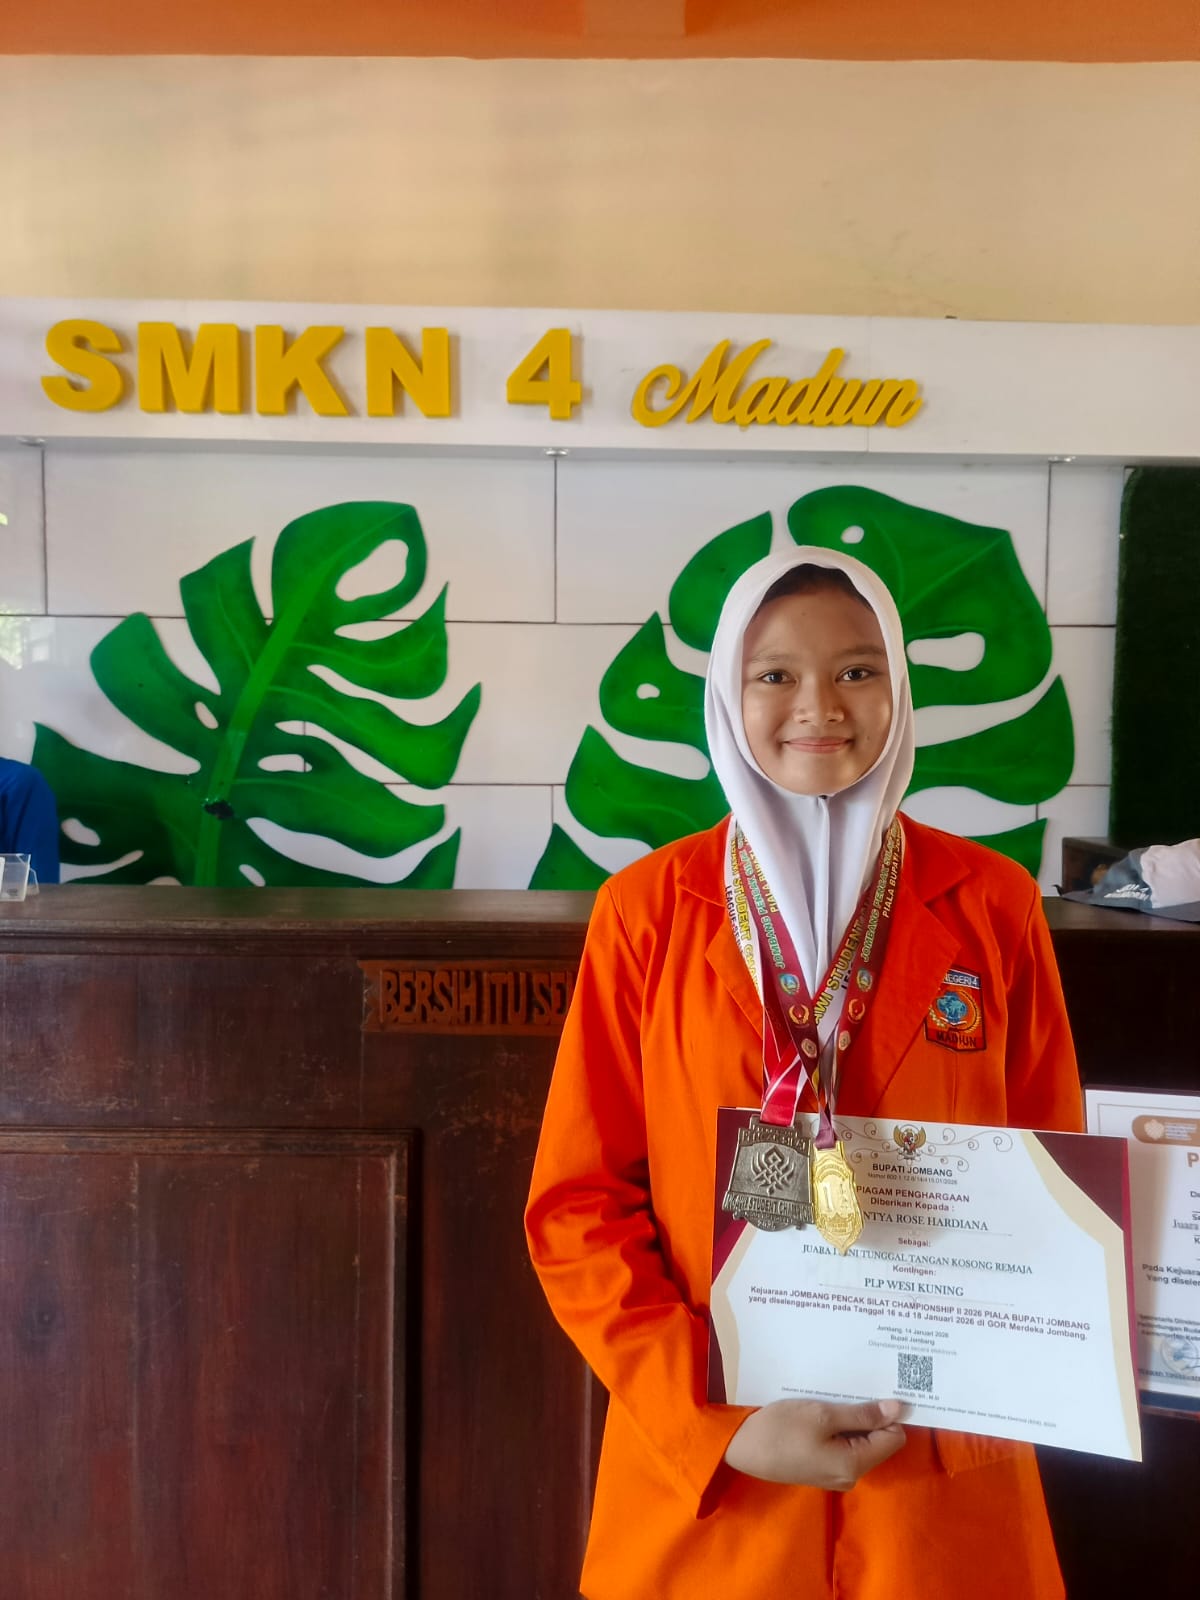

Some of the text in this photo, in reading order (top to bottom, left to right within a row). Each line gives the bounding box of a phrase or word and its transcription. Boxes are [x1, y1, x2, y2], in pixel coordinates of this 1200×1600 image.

[41, 319, 923, 428] SMKN 4 Madiun
[733, 876, 751, 940] STUDENT
[882, 889, 895, 918] PIALA
[761, 916, 785, 969] JOMBANG
[861, 908, 881, 962] JOMBANG
[381, 969, 478, 1026] BERSIH
[872, 1163, 953, 1178] BUPATI JOMBANG
[856, 1186, 892, 1197] PIAGAM
[895, 1189, 970, 1203] PENGHARGAAN
[871, 1197, 912, 1208] Diberikan
[915, 1201, 949, 1211] Kepada
[863, 1211, 989, 1232] NTYA ROSE HARDIANA
[802, 1244, 833, 1256] JUARA
[861, 1250, 907, 1263] TUNGGAL
[909, 1254, 949, 1266] TANGAN
[951, 1257, 993, 1271] KOSONG
[995, 1262, 1033, 1275] REMAJA
[864, 1277, 964, 1297] PLP WESI KUNING
[748, 1295, 767, 1305] yang
[768, 1296, 831, 1310] diselenggarakan
[832, 1302, 852, 1314] pada
[853, 1304, 884, 1316] Tanggal
[923, 1312, 954, 1323] Januari
[956, 1316, 975, 1326] 2026
[987, 1319, 1006, 1329] GOR
[1009, 1323, 1044, 1334] Merdeka
[750, 1285, 788, 1297] Kejuaraan
[789, 1289, 830, 1301] JOMBANG
[831, 1294, 864, 1305] PENCAK
[866, 1297, 889, 1308] SILAT
[891, 1300, 954, 1314] CHAMPIONSHIP
[964, 1307, 982, 1318] 2026
[984, 1310, 1009, 1320] PIALA
[1012, 1313, 1044, 1325] BUPATI
[1046, 1318, 1091, 1331] JOMBANG
